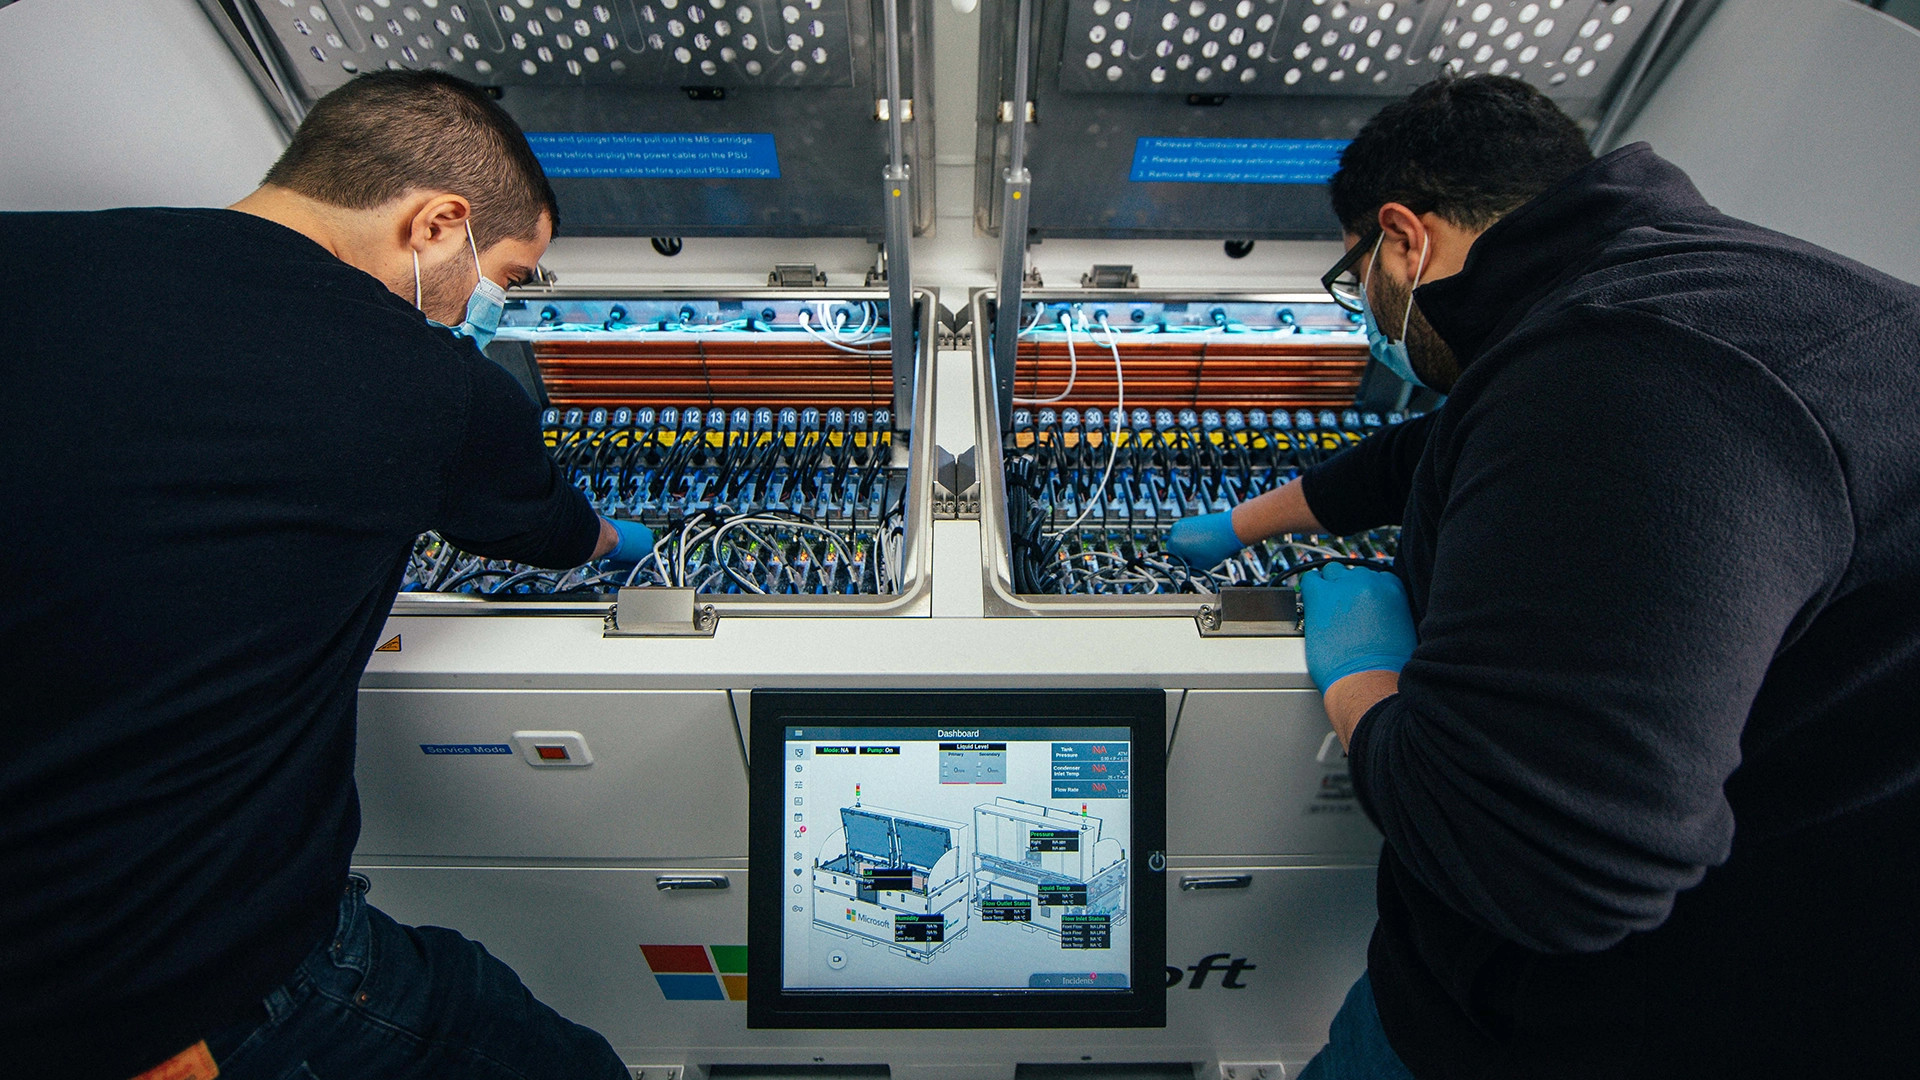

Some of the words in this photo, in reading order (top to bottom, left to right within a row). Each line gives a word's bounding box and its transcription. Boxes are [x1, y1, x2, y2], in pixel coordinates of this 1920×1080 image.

[678, 136, 693, 144] the
[694, 136, 710, 144] MB
[672, 151, 696, 159] cable
[711, 151, 726, 159] the
[709, 166, 729, 174] PSU
[547, 412, 555, 424] 6
[571, 412, 579, 424] 7
[594, 412, 602, 424] 8
[620, 412, 627, 424] 9
[640, 412, 652, 424] 10
[664, 412, 675, 424] 11
[686, 412, 700, 424] 12
[710, 412, 722, 424] 13
[735, 411, 747, 423] 14
[758, 411, 770, 423] 15
[782, 411, 795, 423] 16
[804, 411, 817, 423] 17
[830, 411, 842, 423] 18
[852, 411, 865, 423] 19
[876, 411, 889, 423] 20
[1016, 412, 1029, 424] 27
[1064, 412, 1078, 424] 29
[1088, 412, 1100, 424] 30
[1135, 412, 1148, 424] 32
[1158, 412, 1172, 424] 33
[1182, 412, 1196, 424] 34
[1204, 412, 1219, 425] 35
[1228, 412, 1242, 425] 36
[1251, 412, 1265, 425] 37
[1275, 412, 1289, 425] 38
[1322, 412, 1336, 425] 40
[937, 729, 980, 738] Dashboard
[1092, 745, 1108, 754] NA
[1092, 764, 1108, 772] NA
[1092, 782, 1108, 792] NA
[858, 913, 890, 929] Microsoft
